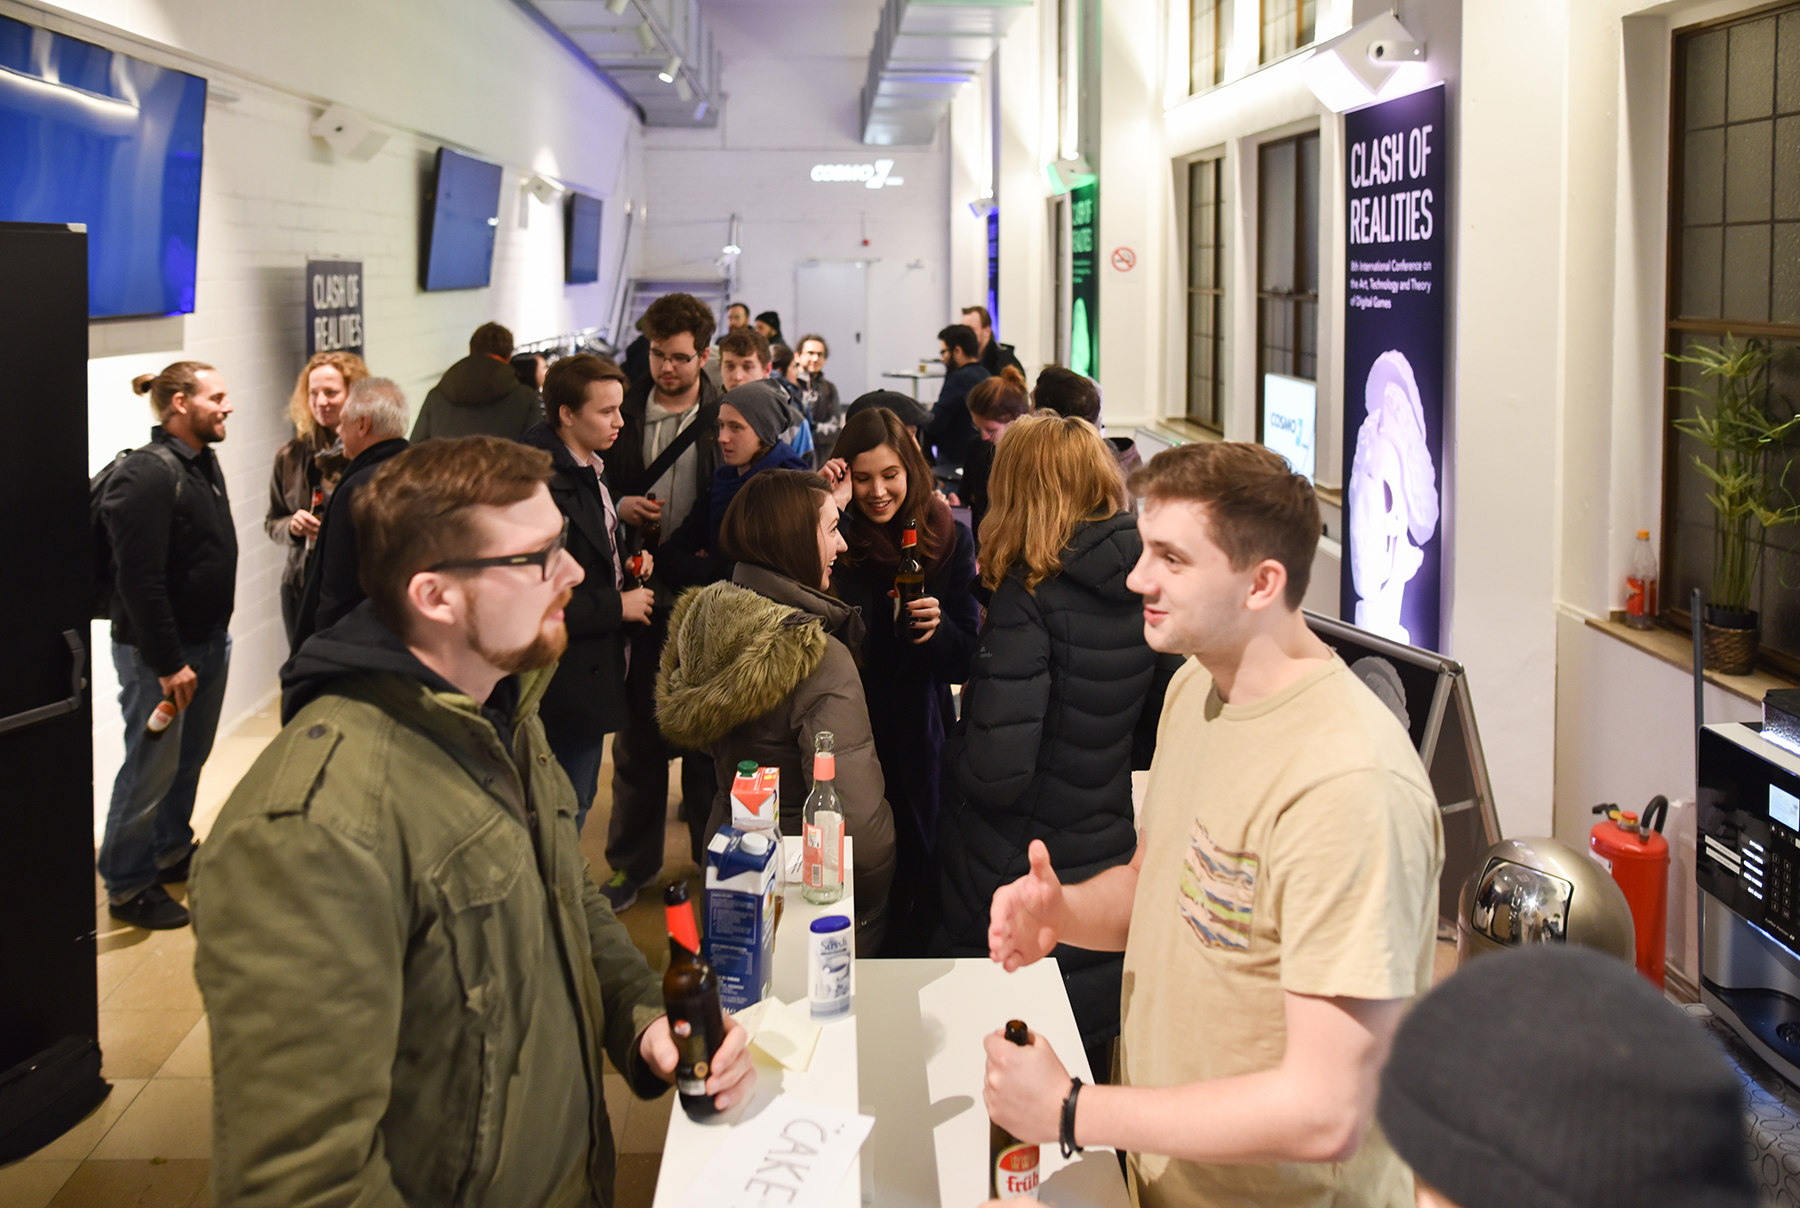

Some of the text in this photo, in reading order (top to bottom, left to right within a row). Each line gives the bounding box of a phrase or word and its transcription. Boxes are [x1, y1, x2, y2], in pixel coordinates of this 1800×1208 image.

[1351, 124, 1433, 189] CLASH OF
[1350, 188, 1434, 244] REALITIES
[1360, 259, 1391, 273] International
[1391, 258, 1422, 272] Conference
[1423, 261, 1432, 271] on
[313, 273, 360, 310] CLASH OF
[1350, 278, 1359, 289] the
[1369, 277, 1399, 293] Technology
[1400, 277, 1410, 290] and
[1410, 277, 1432, 294] Theory
[1355, 294, 1373, 310] Digital
[1373, 295, 1392, 309] Games
[314, 313, 362, 353] REALITIES
[1271, 412, 1296, 434] COSMO
